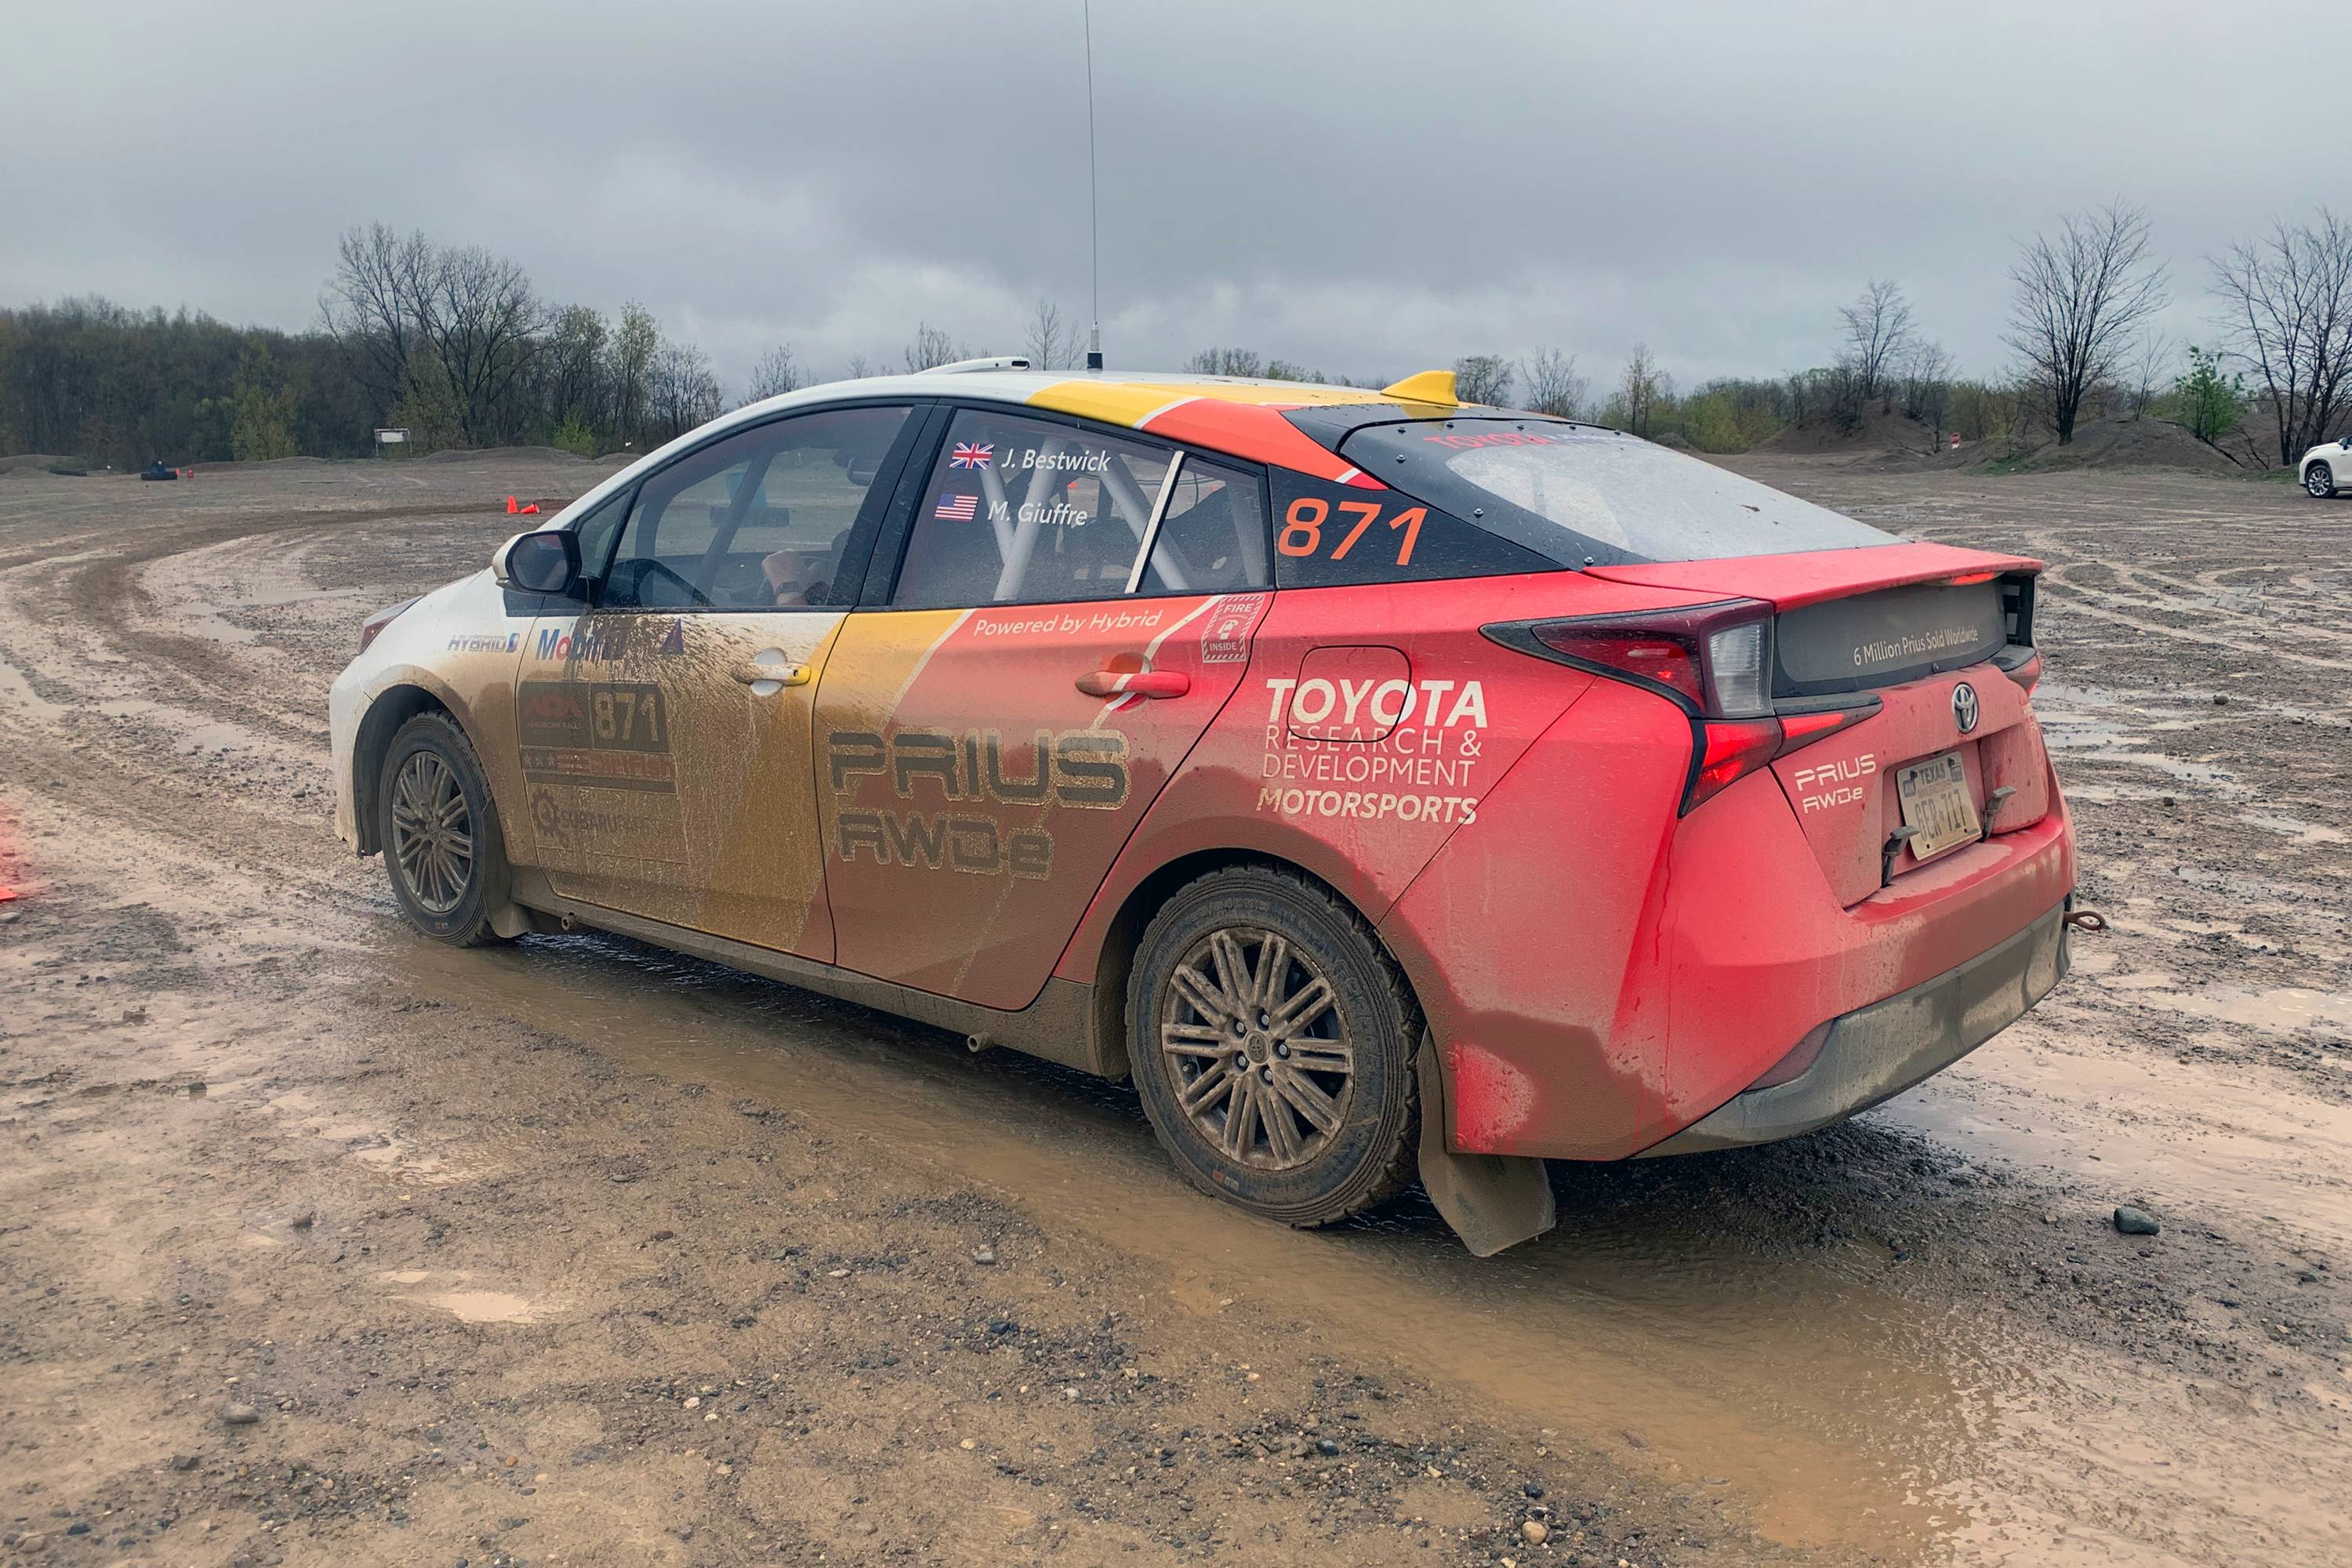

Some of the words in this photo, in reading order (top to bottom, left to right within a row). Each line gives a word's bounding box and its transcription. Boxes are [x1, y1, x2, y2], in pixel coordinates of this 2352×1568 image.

[1001, 448, 1016, 469] J.
[1022, 449, 1111, 471] Bestwick
[987, 500, 1010, 521] M.
[1018, 503, 1089, 526] Giuffre
[1277, 497, 1428, 566] 871
[973, 615, 1058, 637] Powered
[1059, 614, 1087, 634] by
[1088, 609, 1164, 633] Hybrid
[1223, 603, 1255, 614] FIRE
[447, 633, 508, 654] HYBRID
[1209, 641, 1237, 652] INSIDE
[1853, 647, 1861, 666] 6
[1863, 641, 1902, 664] Million
[1902, 634, 1926, 655] Prius
[1926, 630, 1945, 650] Sold
[1944, 624, 1979, 646] Worldwide
[594, 691, 659, 742] 871
[1265, 677, 1488, 728] TOYOTA
[1265, 724, 1444, 755] RESEARCH
[1459, 729, 1483, 757] &
[828, 728, 1130, 810] PRIUS
[1261, 753, 1476, 787] DEVELOPMENT
[1795, 753, 1876, 791] PRIUS
[1918, 762, 1946, 786] TEXAS
[1255, 786, 1479, 825] MOTORSPORTS
